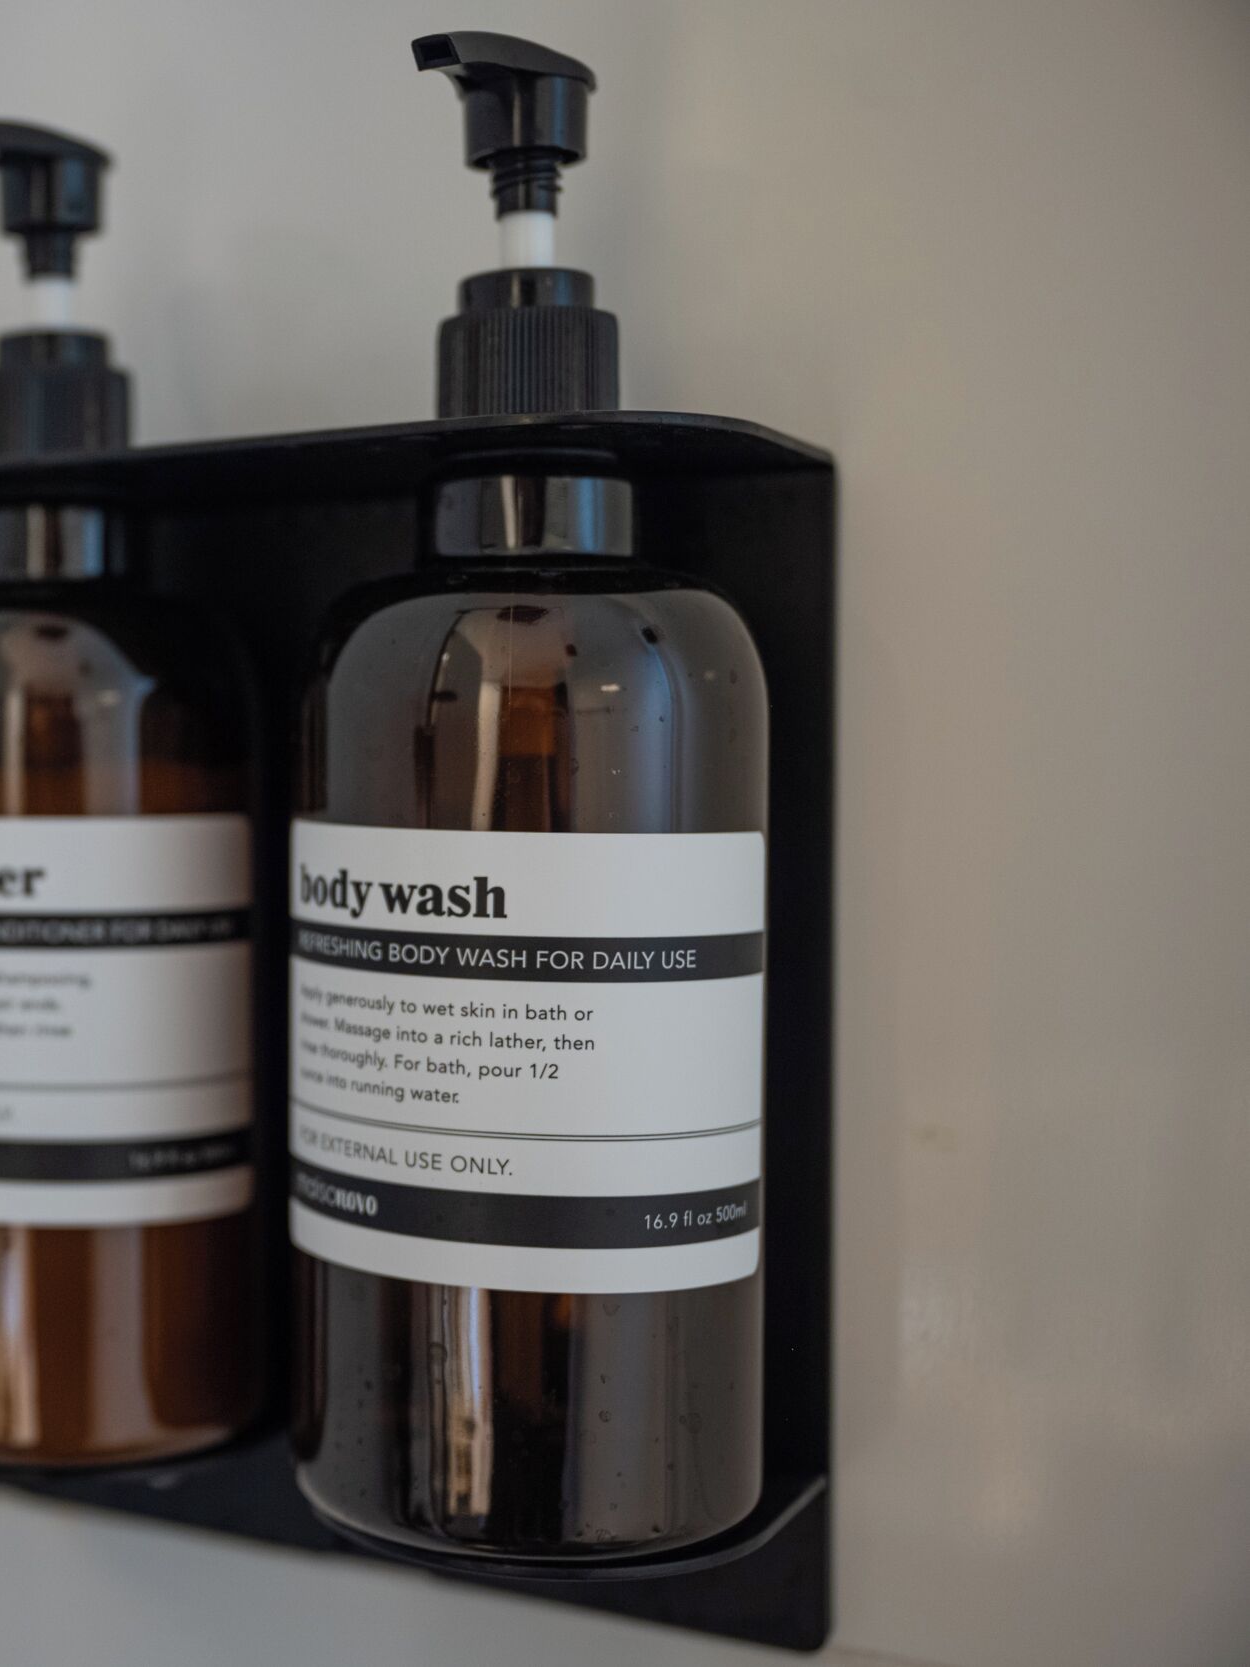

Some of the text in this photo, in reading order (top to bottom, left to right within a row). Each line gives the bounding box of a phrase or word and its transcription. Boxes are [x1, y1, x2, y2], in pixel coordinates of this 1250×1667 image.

[300, 863, 507, 919] body wash
[388, 942, 449, 965] BODY
[456, 947, 527, 969] WASH
[536, 950, 584, 970] FOR
[593, 951, 655, 970] DAILY
[661, 949, 697, 970] USE
[326, 991, 395, 1016] generously
[400, 1000, 417, 1014] to
[423, 1002, 455, 1018] wet
[460, 1001, 495, 1018] skin
[502, 1003, 518, 1019] in
[526, 1003, 567, 1021] bath
[574, 1009, 594, 1021] or
[334, 1017, 391, 1043] Massage
[396, 1025, 428, 1044] into
[434, 1033, 444, 1045] a
[450, 1030, 482, 1047] rich
[489, 1031, 547, 1052] lather,
[554, 1033, 595, 1050] then
[320, 1043, 387, 1071] thoroughly.
[394, 1054, 420, 1071] For
[426, 1056, 471, 1078] bath,
[478, 1064, 522, 1080] pour
[530, 1063, 559, 1079] 1/2
[326, 1073, 347, 1089] into
[350, 1077, 405, 1103] running
[410, 1088, 459, 1104] water.
[320, 1132, 397, 1166] EXTERNAL
[405, 1151, 442, 1170] USE
[450, 1155, 513, 1176] ONLY.
[644, 1200, 747, 1230] 16.9 fl oz 500ml
